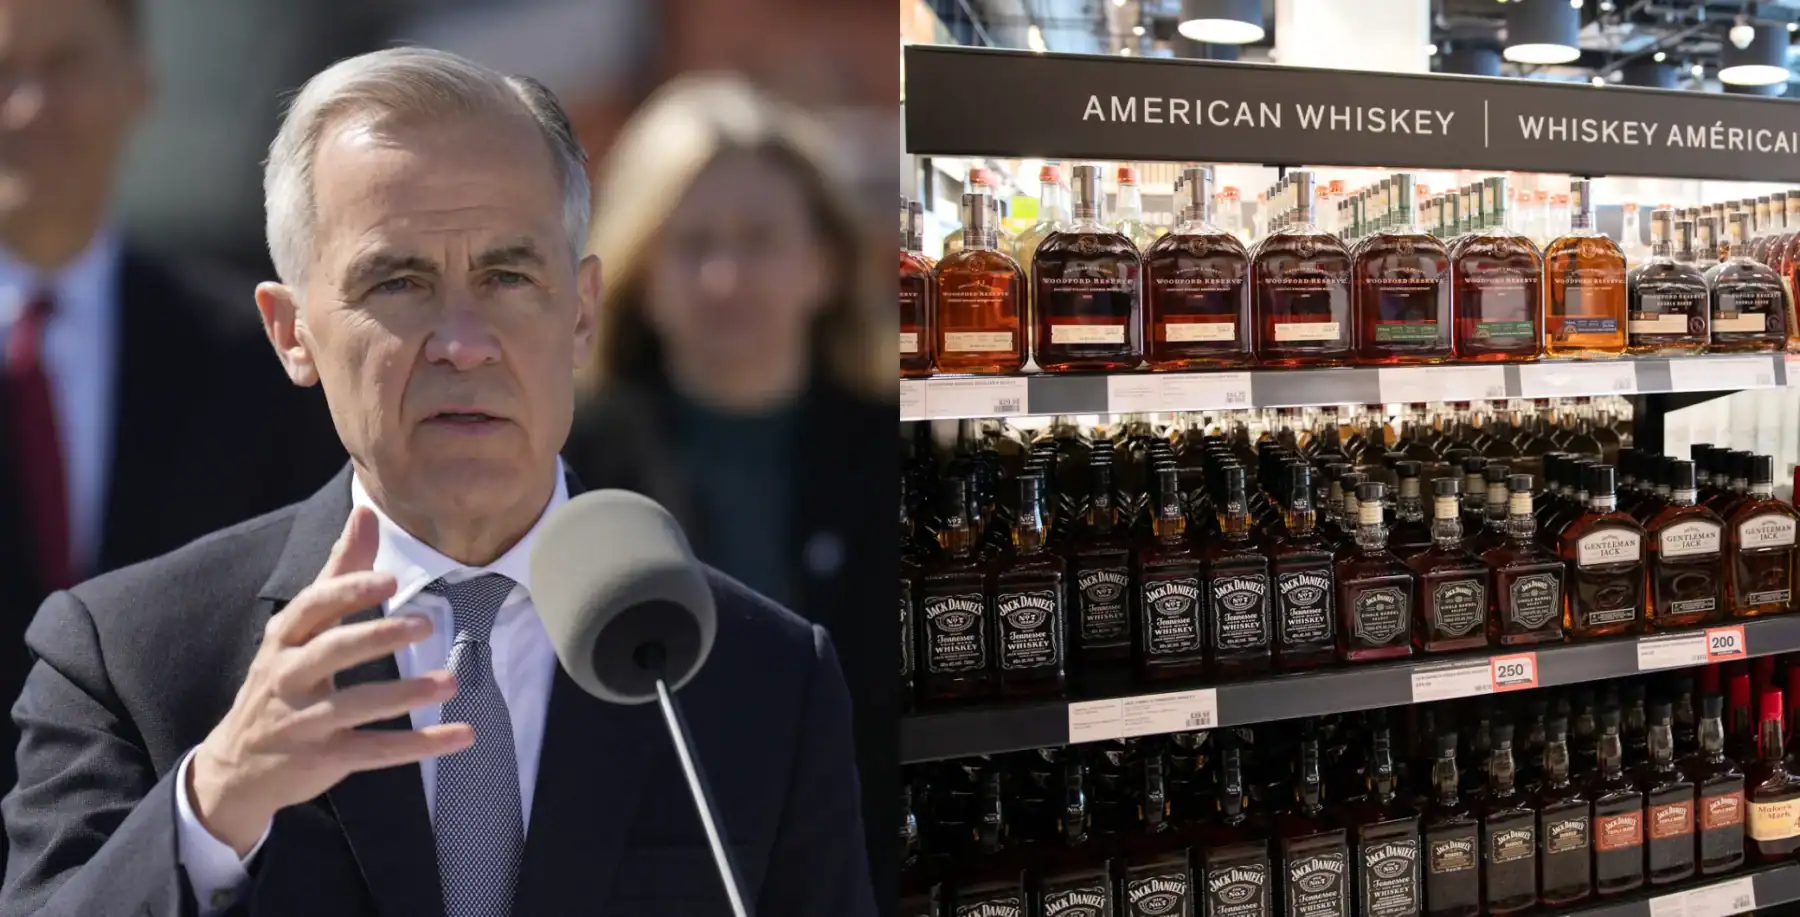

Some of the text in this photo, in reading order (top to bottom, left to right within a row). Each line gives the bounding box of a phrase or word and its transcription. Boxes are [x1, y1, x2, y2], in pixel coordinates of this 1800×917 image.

[1082, 94, 1455, 136] AMERICAN WHISKEY
[1518, 114, 1658, 146] WHISKEY
[1745, 524, 1792, 535] GENTLEMAN
[1666, 531, 1716, 543] GENTLEMAN
[1760, 532, 1779, 541] JACK
[1584, 539, 1636, 550] GENTLEMAN
[1682, 540, 1701, 549] JACK
[1600, 548, 1621, 557] JACK
[1078, 575, 1098, 591] JACK
[1214, 579, 1266, 599] JACK DANIEL'S
[1279, 574, 1330, 594] JACK DANIEL'S
[1146, 583, 1200, 603] JACK DANIEL'S
[925, 602, 947, 620] JACK
[948, 598, 985, 615] DANIEL'S
[998, 595, 1056, 617] JACK DANIEL'S
[1222, 621, 1260, 631] WHISKEY
[1287, 616, 1325, 625] WHISKEY
[1154, 626, 1194, 636] WHISKEY
[934, 643, 978, 654] WHISKEY
[1007, 641, 1050, 650] WHISKEY
[1712, 635, 1734, 649] 200
[1498, 663, 1524, 678] 250
[1758, 804, 1792, 813] Maker's
[1768, 811, 1791, 820] Mark
[1365, 845, 1418, 867] JACK DANIEL'S
[1291, 859, 1345, 882] JACK DANIEL'S
[1209, 869, 1266, 892] JACK DANIEL'S
[1128, 879, 1187, 902] JACK DANIEL'S
[1374, 886, 1410, 898] WHISKEY
[1045, 893, 1106, 917] JACK DANIEL'S
[1300, 900, 1337, 912] WHISKEY
